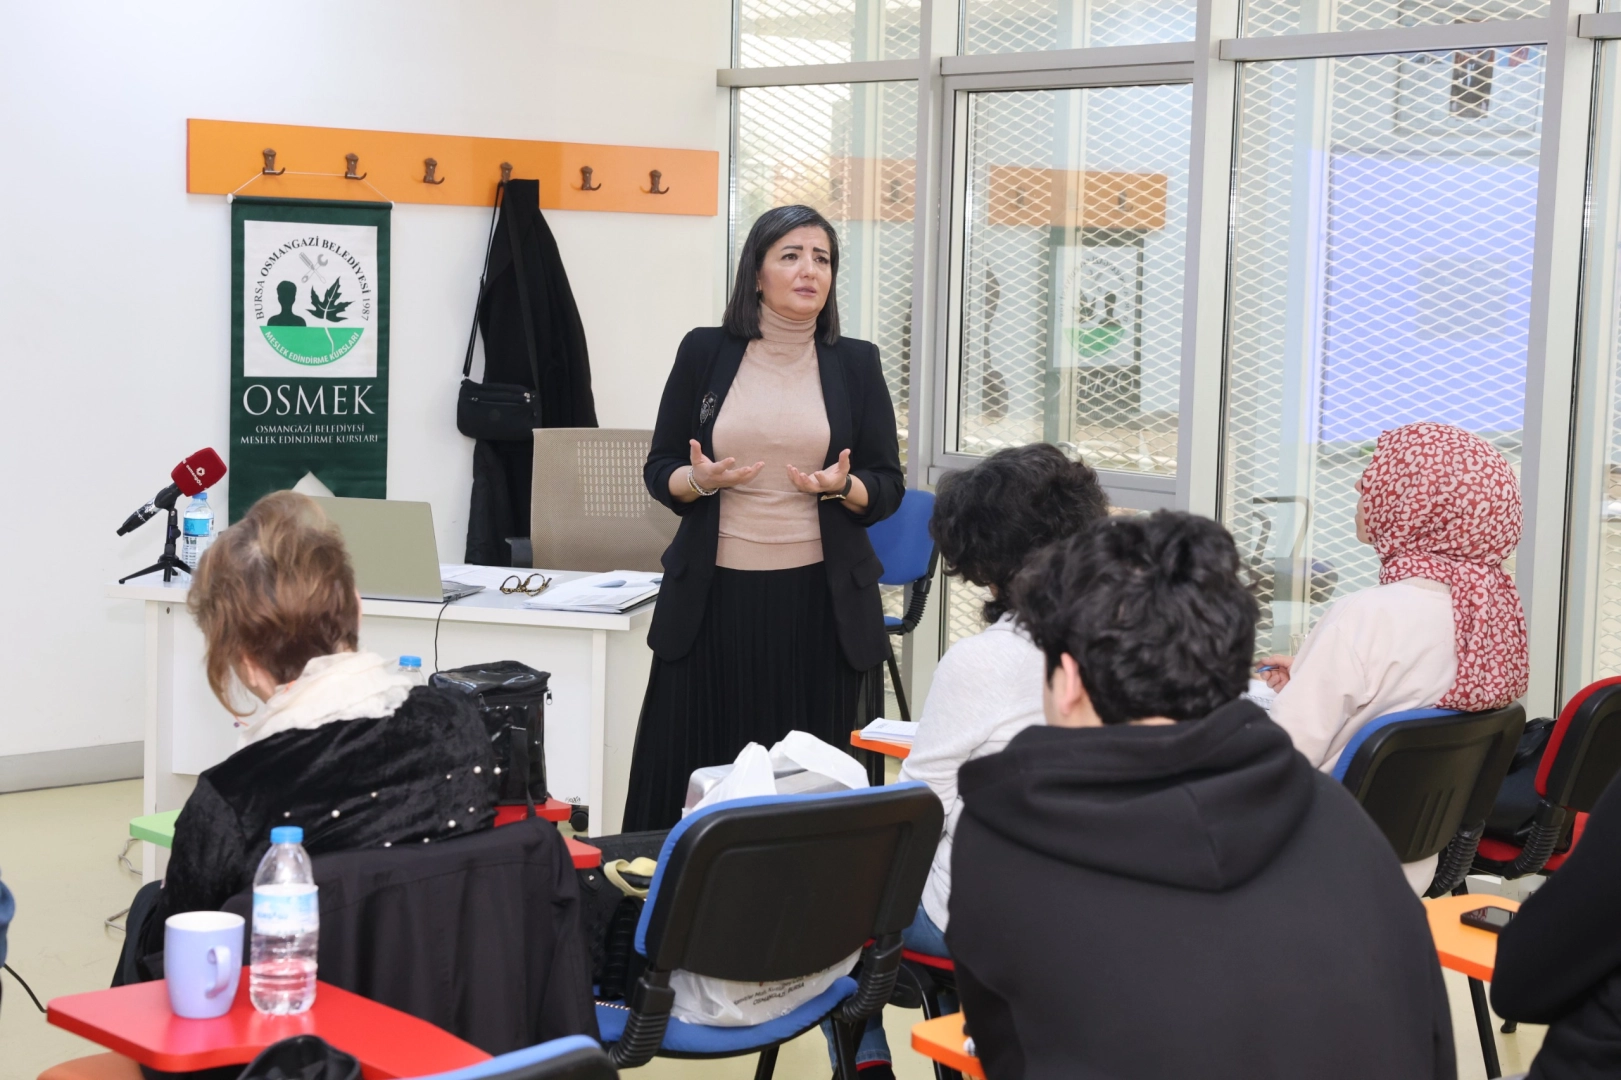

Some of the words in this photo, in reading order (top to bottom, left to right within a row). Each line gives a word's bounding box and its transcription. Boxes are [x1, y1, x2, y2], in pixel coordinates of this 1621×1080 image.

[254, 280, 265, 320] BURSA
[260, 236, 319, 277] OSMANGAZİ
[322, 239, 371, 294] BELEDİYESİ
[361, 298, 371, 321] 1987
[265, 331, 288, 356] MESLEK
[288, 351, 329, 365] EDİNDİRME
[329, 332, 360, 360] KURSLARI
[243, 384, 376, 416] OSMEK
[240, 436, 277, 444] MESLEK
[279, 434, 334, 444] EDİNDİRME
[336, 434, 378, 443] KURSLARI
[255, 423, 312, 433] OSMANGAZİ
[315, 422, 365, 433] BELEDİYESİ
